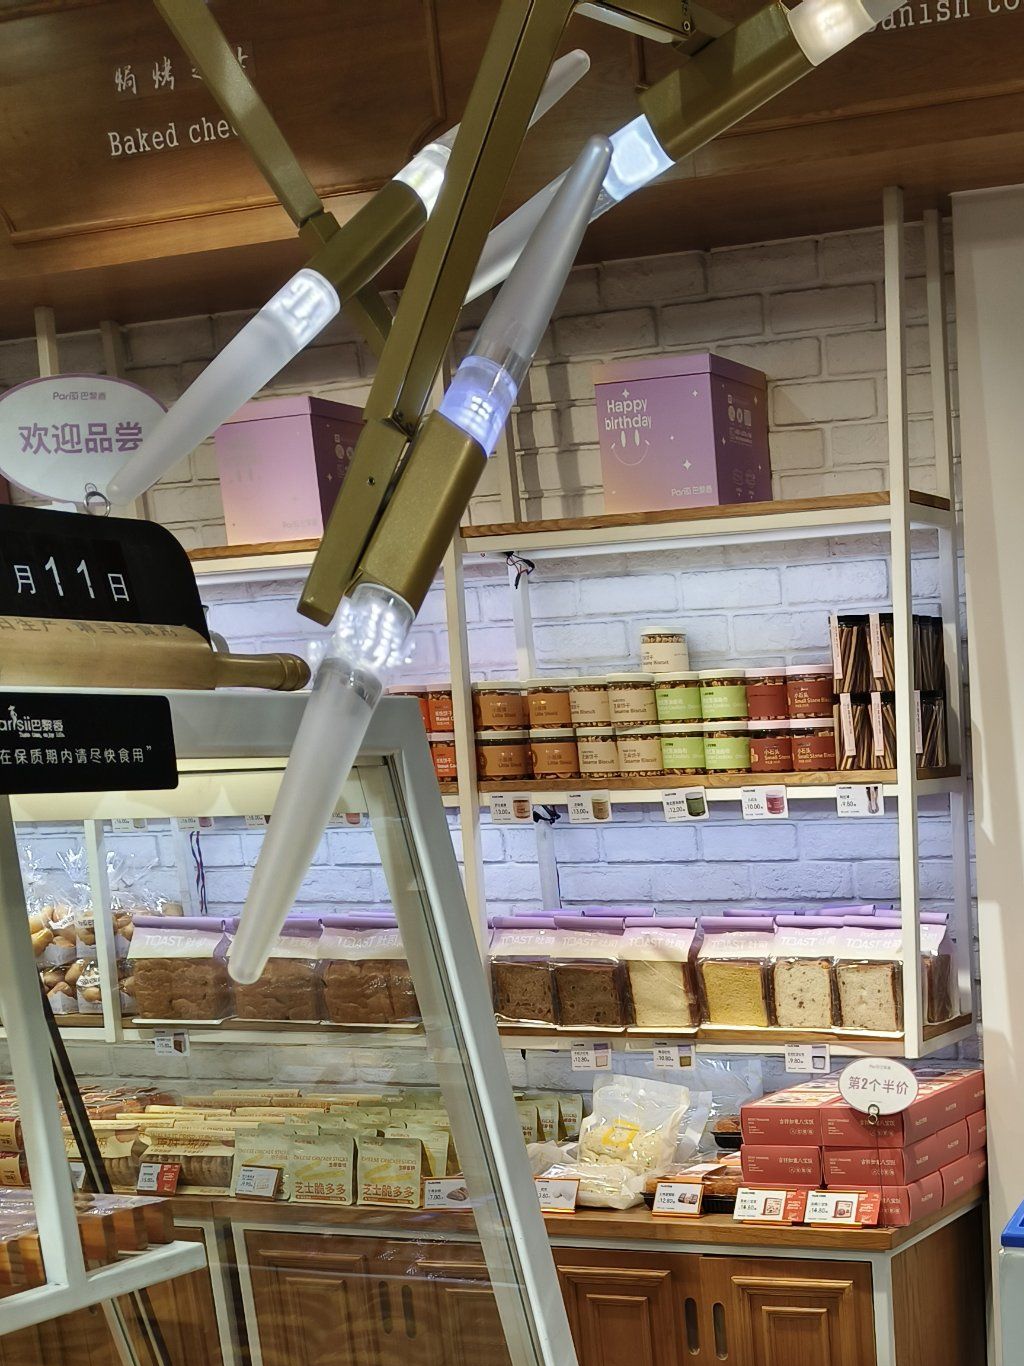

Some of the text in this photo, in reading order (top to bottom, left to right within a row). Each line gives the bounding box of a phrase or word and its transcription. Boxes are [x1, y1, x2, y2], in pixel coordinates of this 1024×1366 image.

[108, 116, 239, 156] Baked che
[607, 399, 648, 414] Happy
[605, 415, 652, 430] birthday
[18, 421, 143, 455] 欢迎品尝
[501, 935, 532, 945] TOAST
[629, 936, 663, 948] TOAST
[781, 935, 816, 947] TOAST
[847, 937, 882, 949] TOAST
[848, 1075, 909, 1096] 第2个半价
[295, 1182, 346, 1195] 芝士脆多多
[363, 1183, 414, 1198] 芝士脆多多
